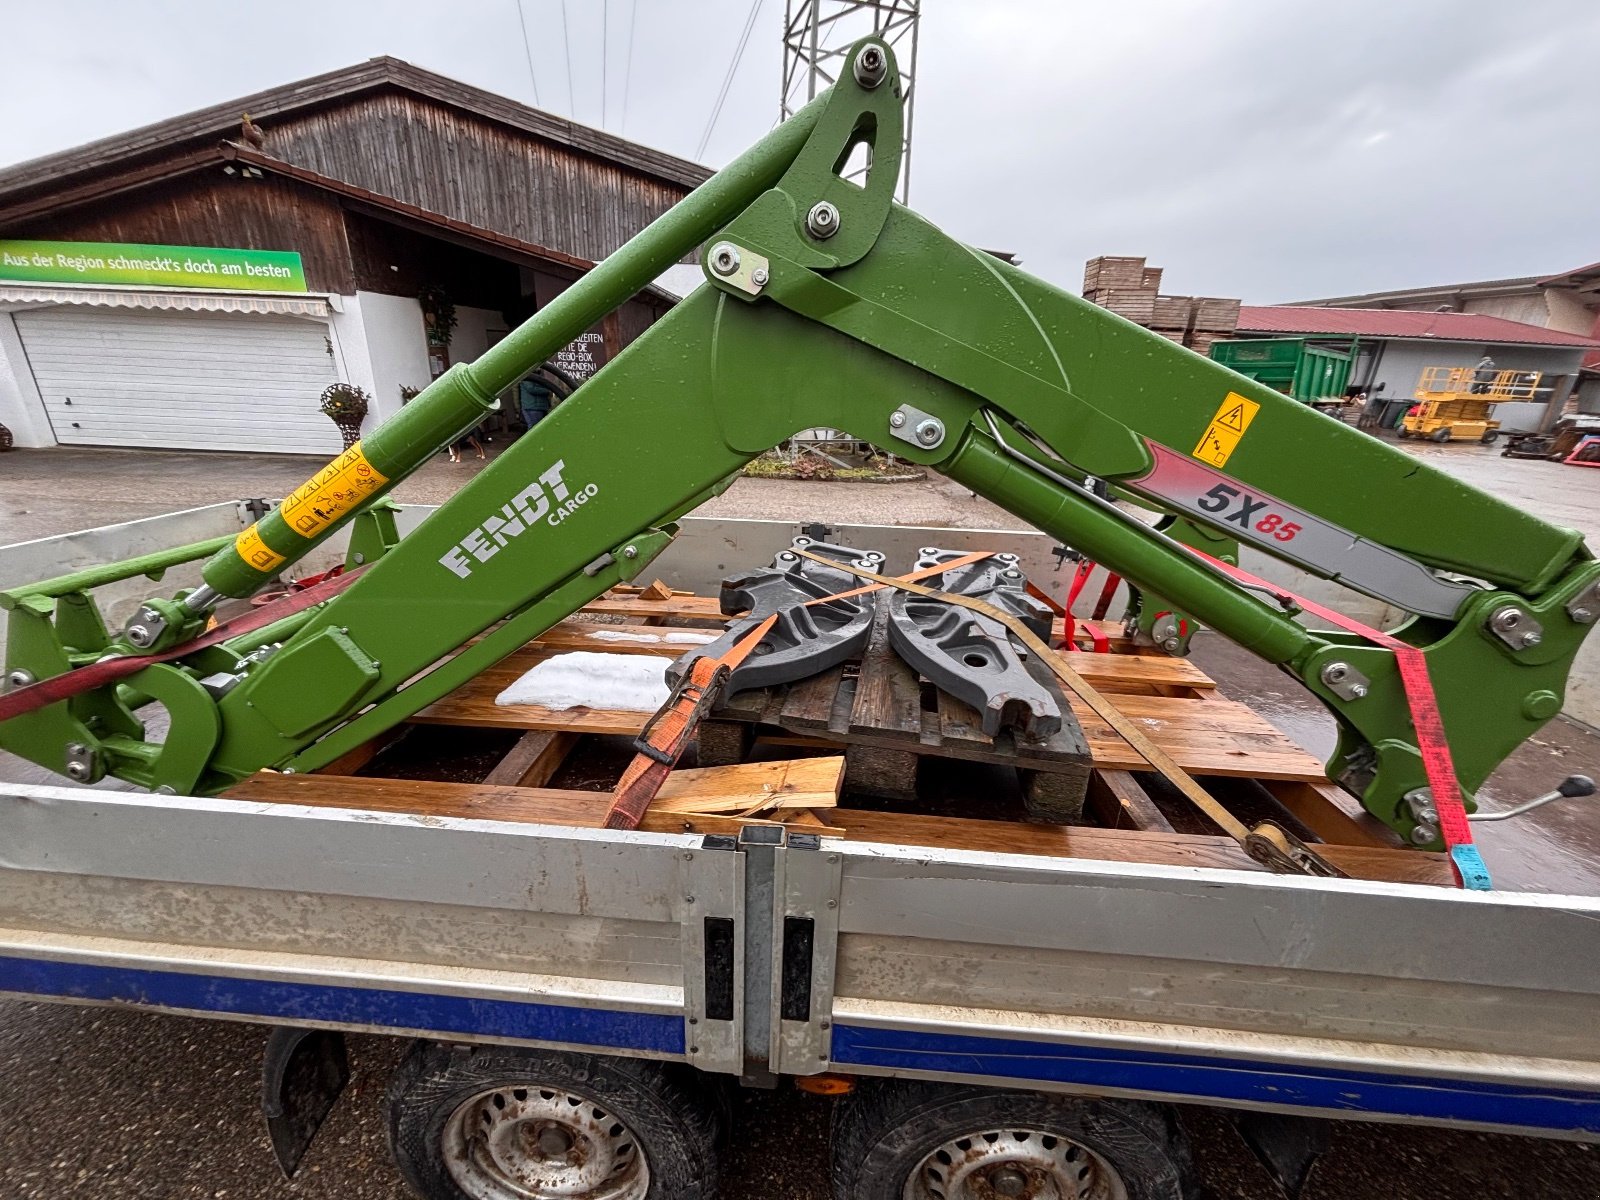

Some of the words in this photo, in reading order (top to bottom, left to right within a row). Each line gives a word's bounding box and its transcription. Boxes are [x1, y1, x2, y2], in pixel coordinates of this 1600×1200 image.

[3, 252, 30, 267] Aus
[32, 253, 54, 267] der
[57, 253, 105, 272] Region
[108, 255, 181, 272] schmeckt's
[184, 258, 218, 274] doch
[221, 263, 243, 275] am
[245, 261, 292, 278] besten
[574, 333, 604, 343] ZEITEN
[438, 459, 569, 579] FENDT
[547, 483, 599, 526] CARGO
